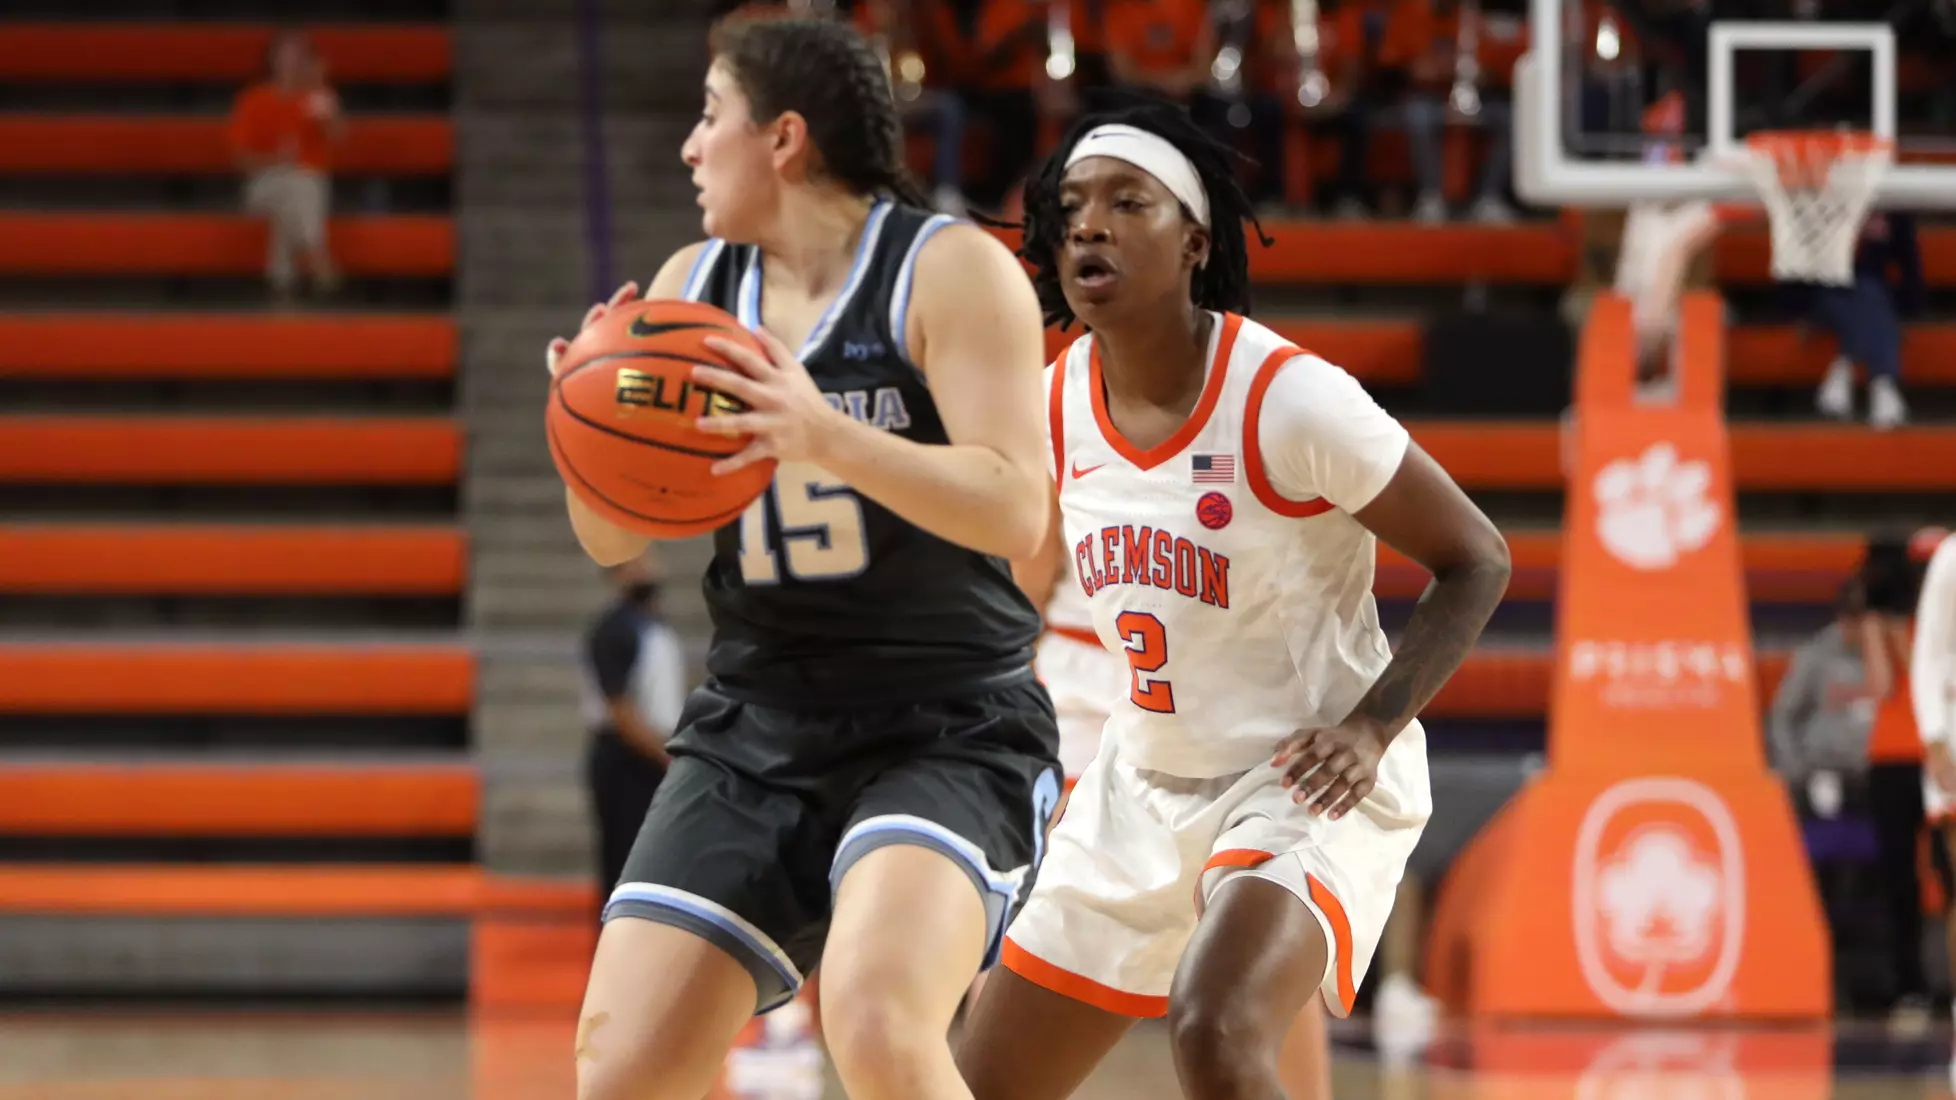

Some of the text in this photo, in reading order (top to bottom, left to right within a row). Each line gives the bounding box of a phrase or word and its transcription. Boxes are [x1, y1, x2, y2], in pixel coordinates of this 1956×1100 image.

[738, 463, 871, 586] 15
[1076, 525, 1230, 609] CLEMSON
[1115, 610, 1176, 714] 2
